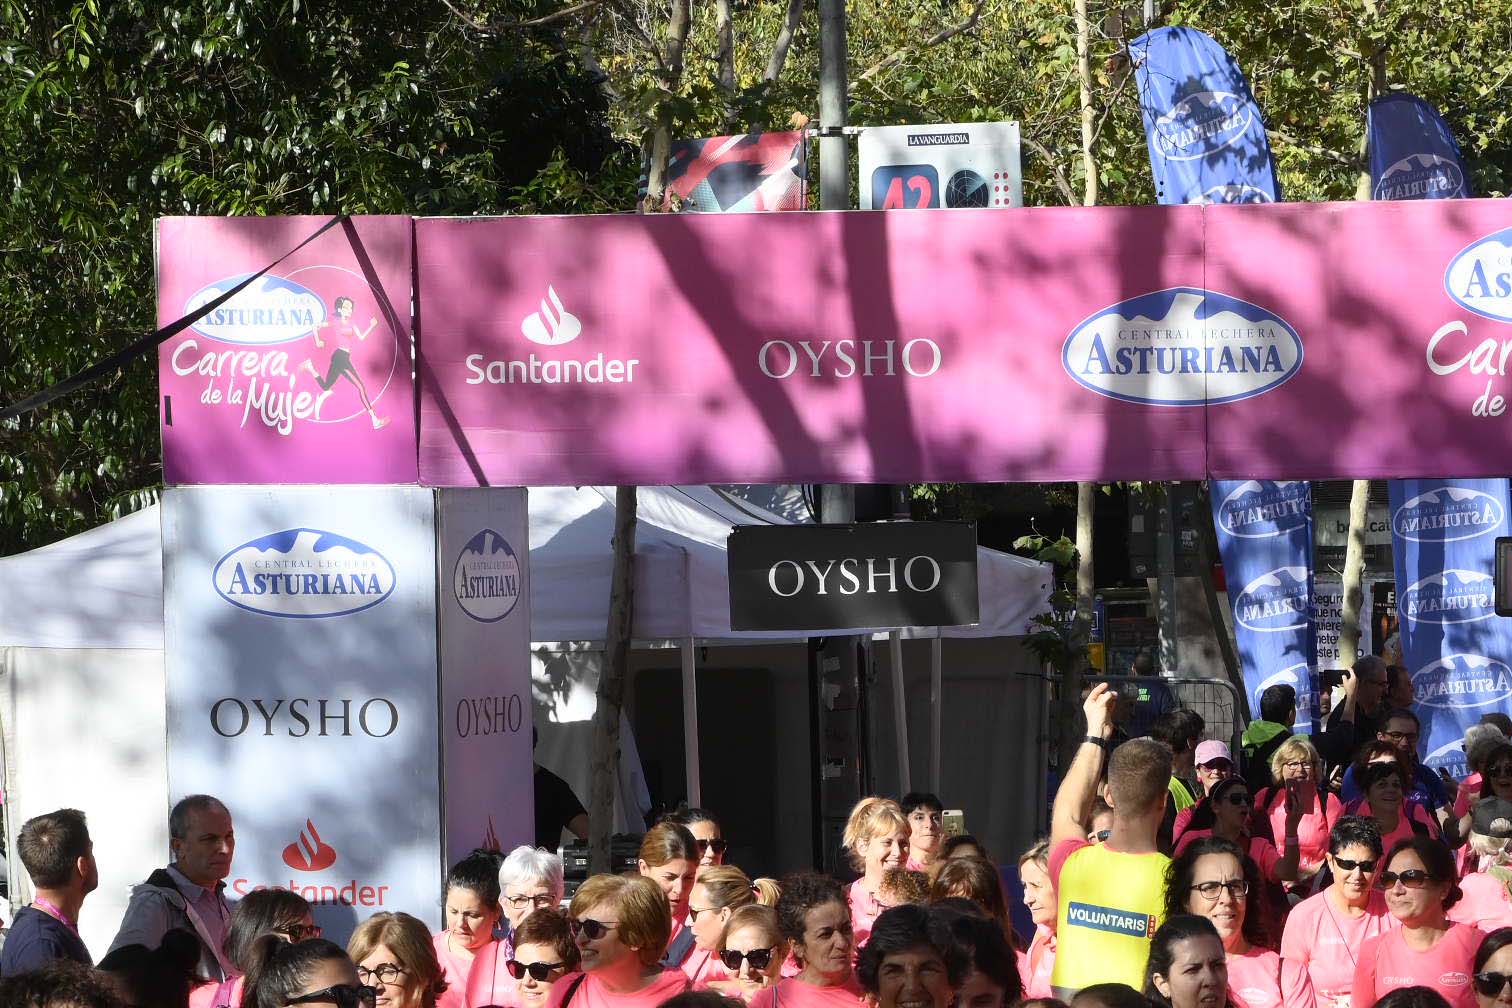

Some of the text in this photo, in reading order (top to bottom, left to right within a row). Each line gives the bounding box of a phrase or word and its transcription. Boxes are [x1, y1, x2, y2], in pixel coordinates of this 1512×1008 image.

[912, 132, 957, 142] VANGUARDIA
[1118, 328, 1190, 341] CENTRAL
[170, 340, 288, 377] Carrera
[465, 353, 639, 386] Santander
[757, 338, 943, 379] OYSHO
[1081, 332, 1285, 376] ASTURIANA
[200, 375, 333, 436] de la Mujer
[1471, 379, 1506, 418] de
[227, 562, 384, 595] ASTURIANA
[254, 559, 313, 569] CENTRAL
[459, 564, 517, 600] ASTURIANA
[767, 555, 941, 597] OYSHO
[210, 697, 399, 738] OYSHO
[456, 693, 521, 738] OYSHO
[1069, 907, 1146, 931] VOLUNTARIS
